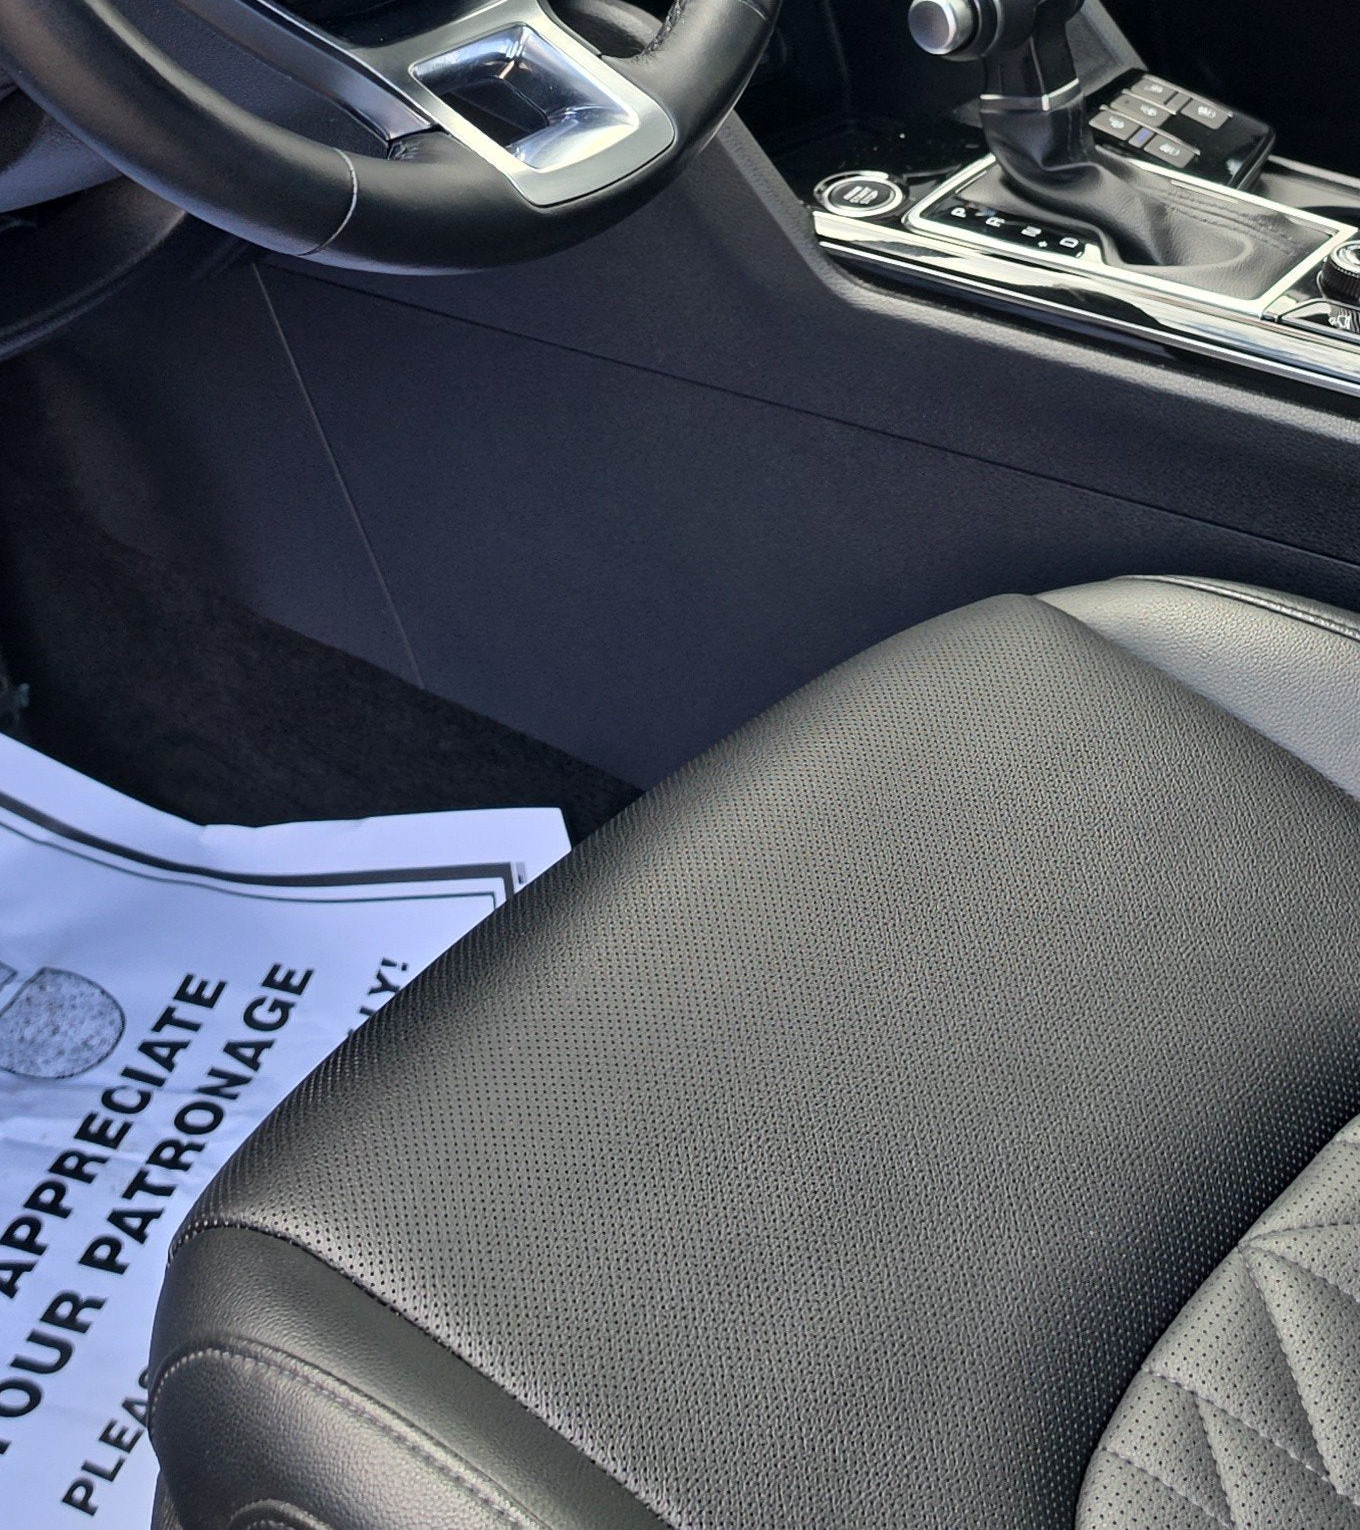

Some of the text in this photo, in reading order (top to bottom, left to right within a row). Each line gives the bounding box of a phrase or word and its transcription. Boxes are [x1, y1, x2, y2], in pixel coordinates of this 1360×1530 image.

[950, 206, 967, 219] P
[985, 216, 1006, 229] R
[1058, 236, 1080, 249] D
[76, 962, 316, 1277] PATRONAGE
